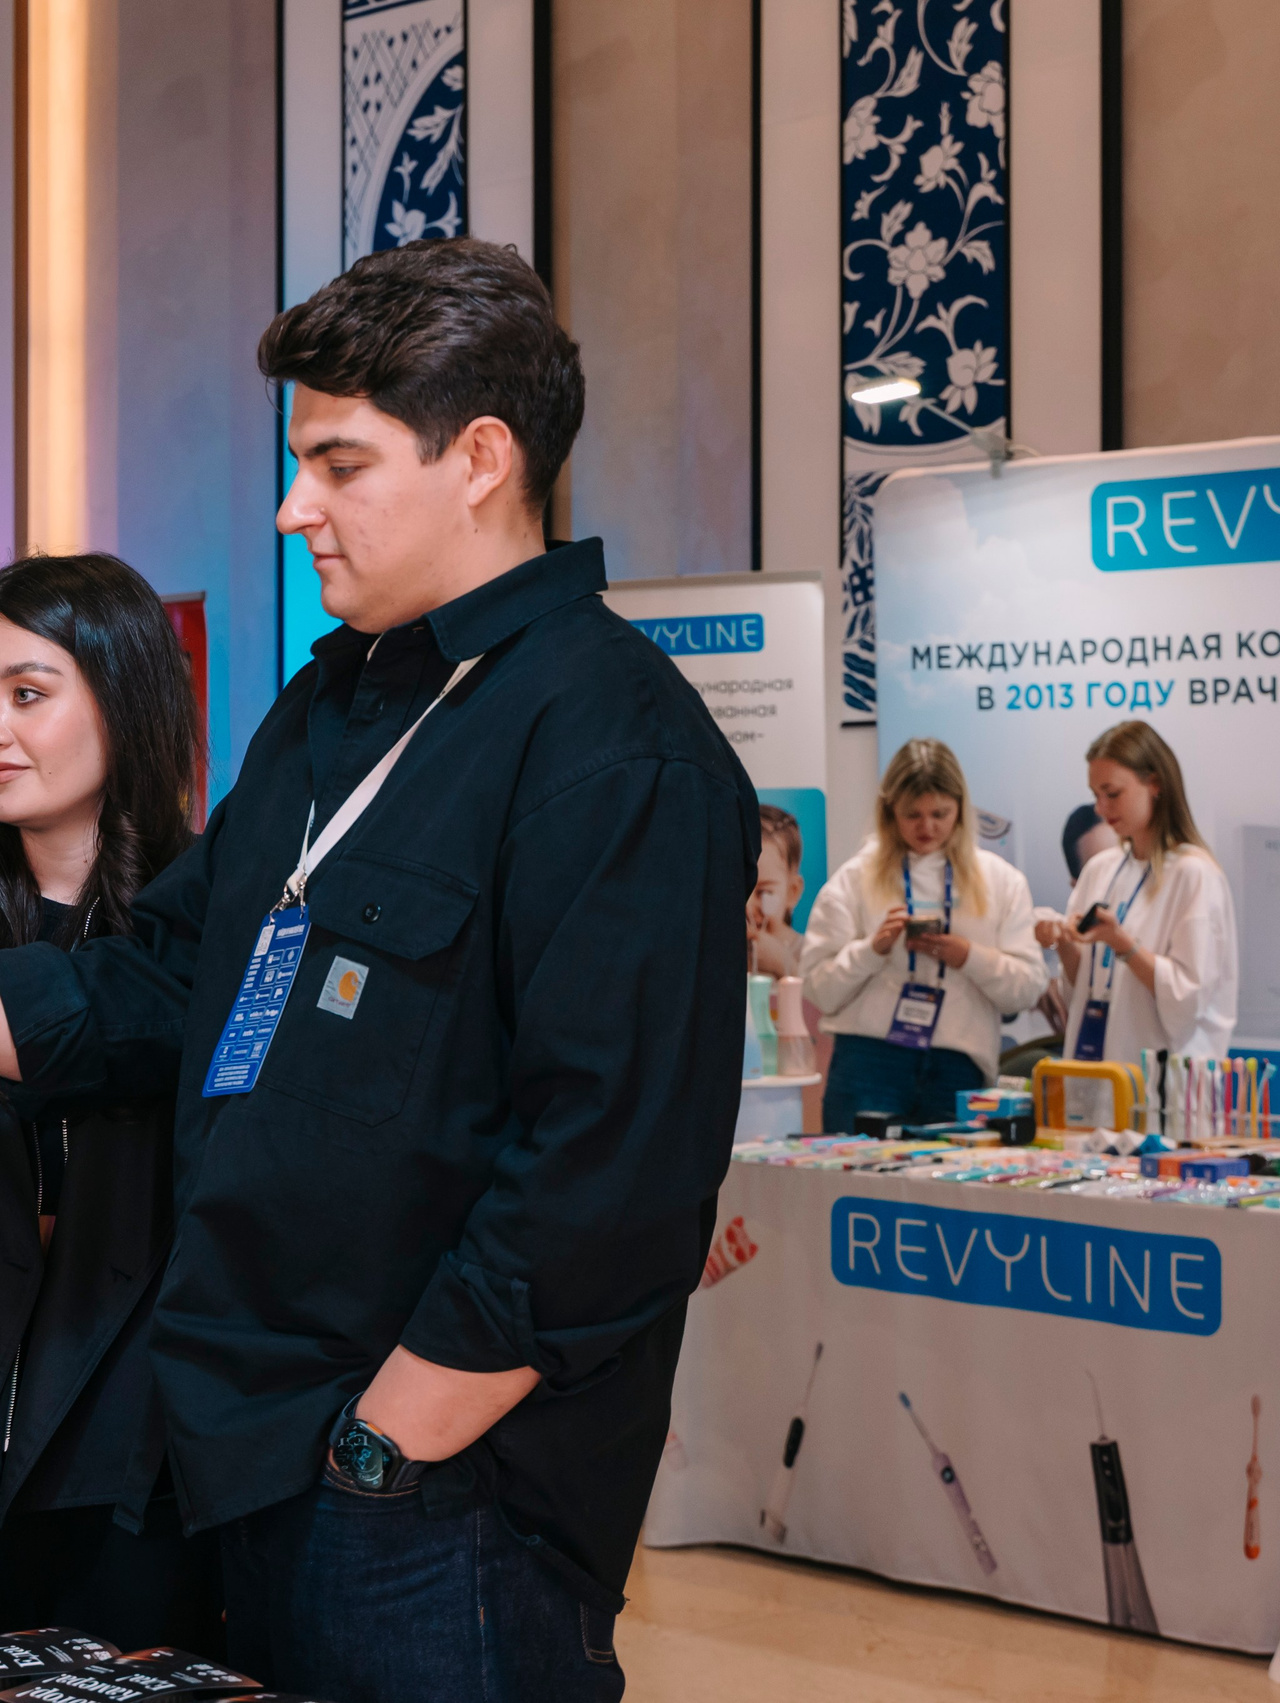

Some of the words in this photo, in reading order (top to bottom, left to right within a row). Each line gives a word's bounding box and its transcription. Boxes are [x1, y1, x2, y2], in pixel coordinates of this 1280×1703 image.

[640, 619, 758, 650] VYLINE
[911, 634, 1221, 672] МЕЖДУНАРОДНАЯ
[693, 679, 794, 697] ународная
[977, 686, 995, 711] В
[1006, 683, 1074, 712] 2013
[1086, 680, 1175, 712] ГОДУ
[1189, 676, 1277, 706] ВРАЧ
[710, 703, 778, 720] ванная
[847, 1212, 1205, 1320] REVYLINE
[42, 1673, 143, 1701] Камера!
[115, 1673, 177, 1692] Еда!
